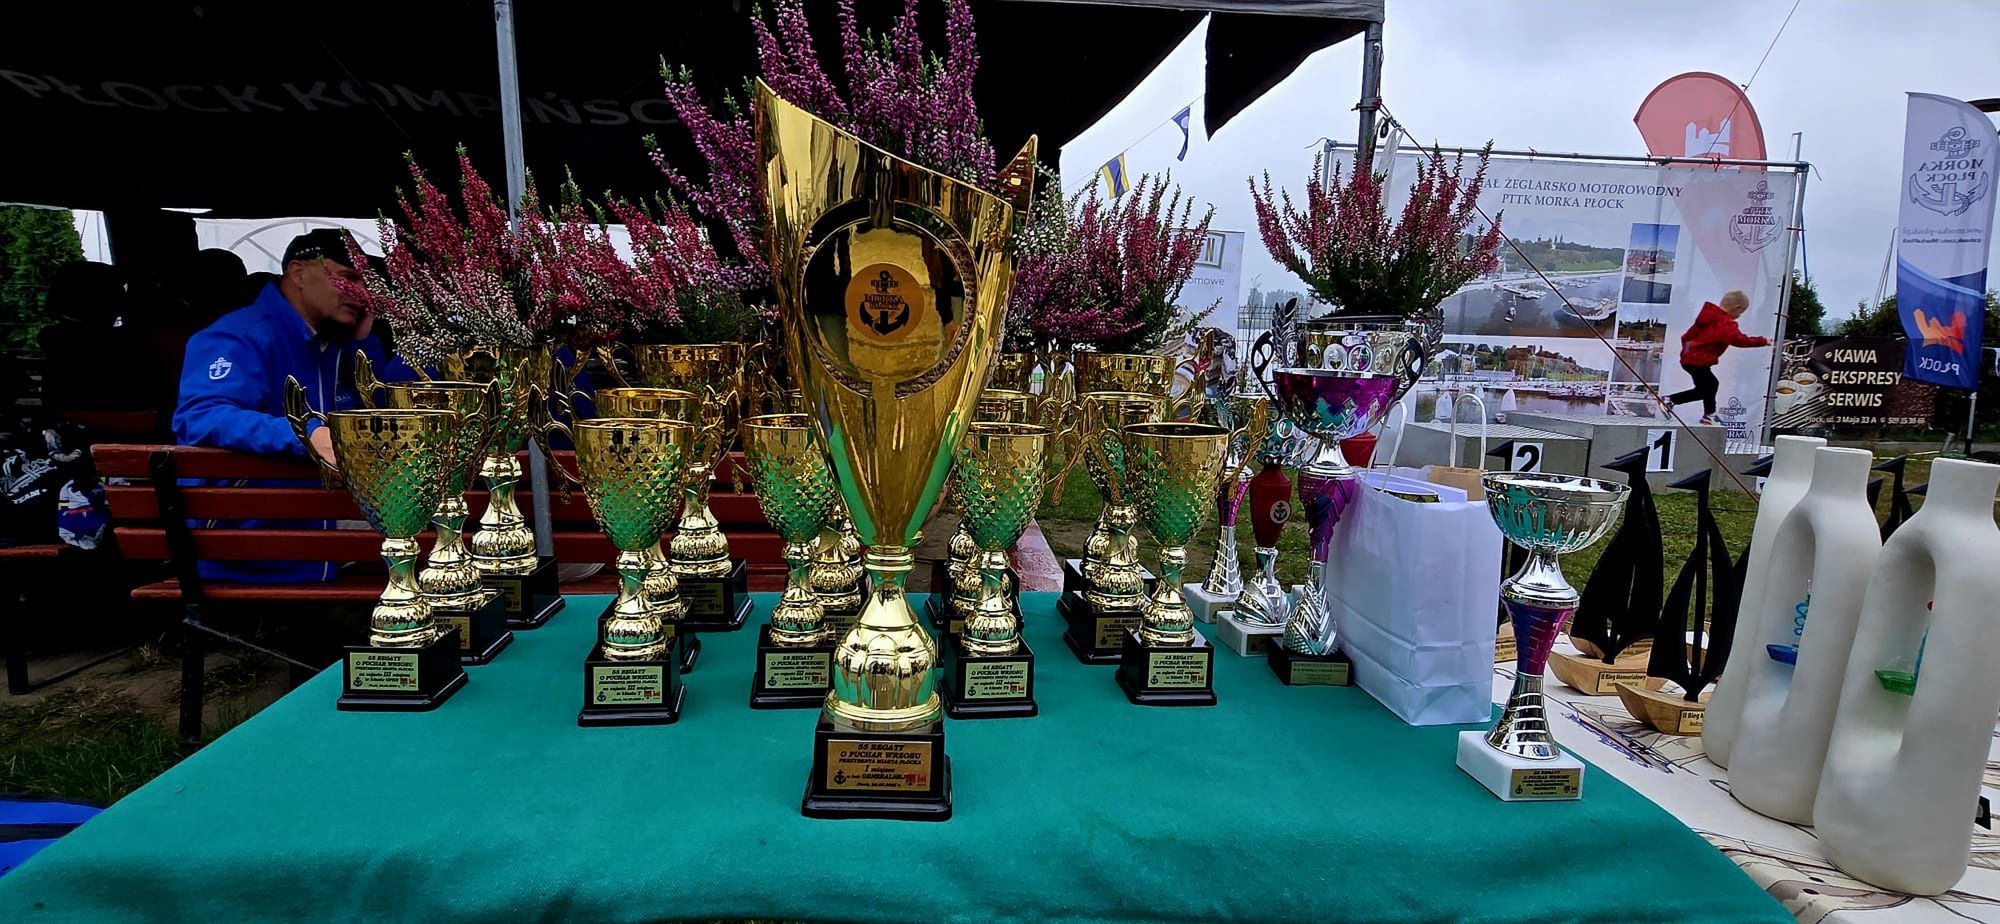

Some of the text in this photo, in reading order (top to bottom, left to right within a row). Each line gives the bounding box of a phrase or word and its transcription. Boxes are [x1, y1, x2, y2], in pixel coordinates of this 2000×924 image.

[1504, 177, 1576, 193] ŻEGLARSKO
[1579, 182, 1683, 198] MOTOROWODNY
[1502, 194, 1624, 209] PTTK MORKA PŁOCK
[1738, 216, 1776, 225] MORKA
[1834, 350, 1878, 364] KAWA
[1830, 371, 1901, 386] EKSPRESY
[1828, 393, 1882, 407] SERWIS
[1515, 444, 1541, 472] 2
[1654, 432, 1672, 470] 1
